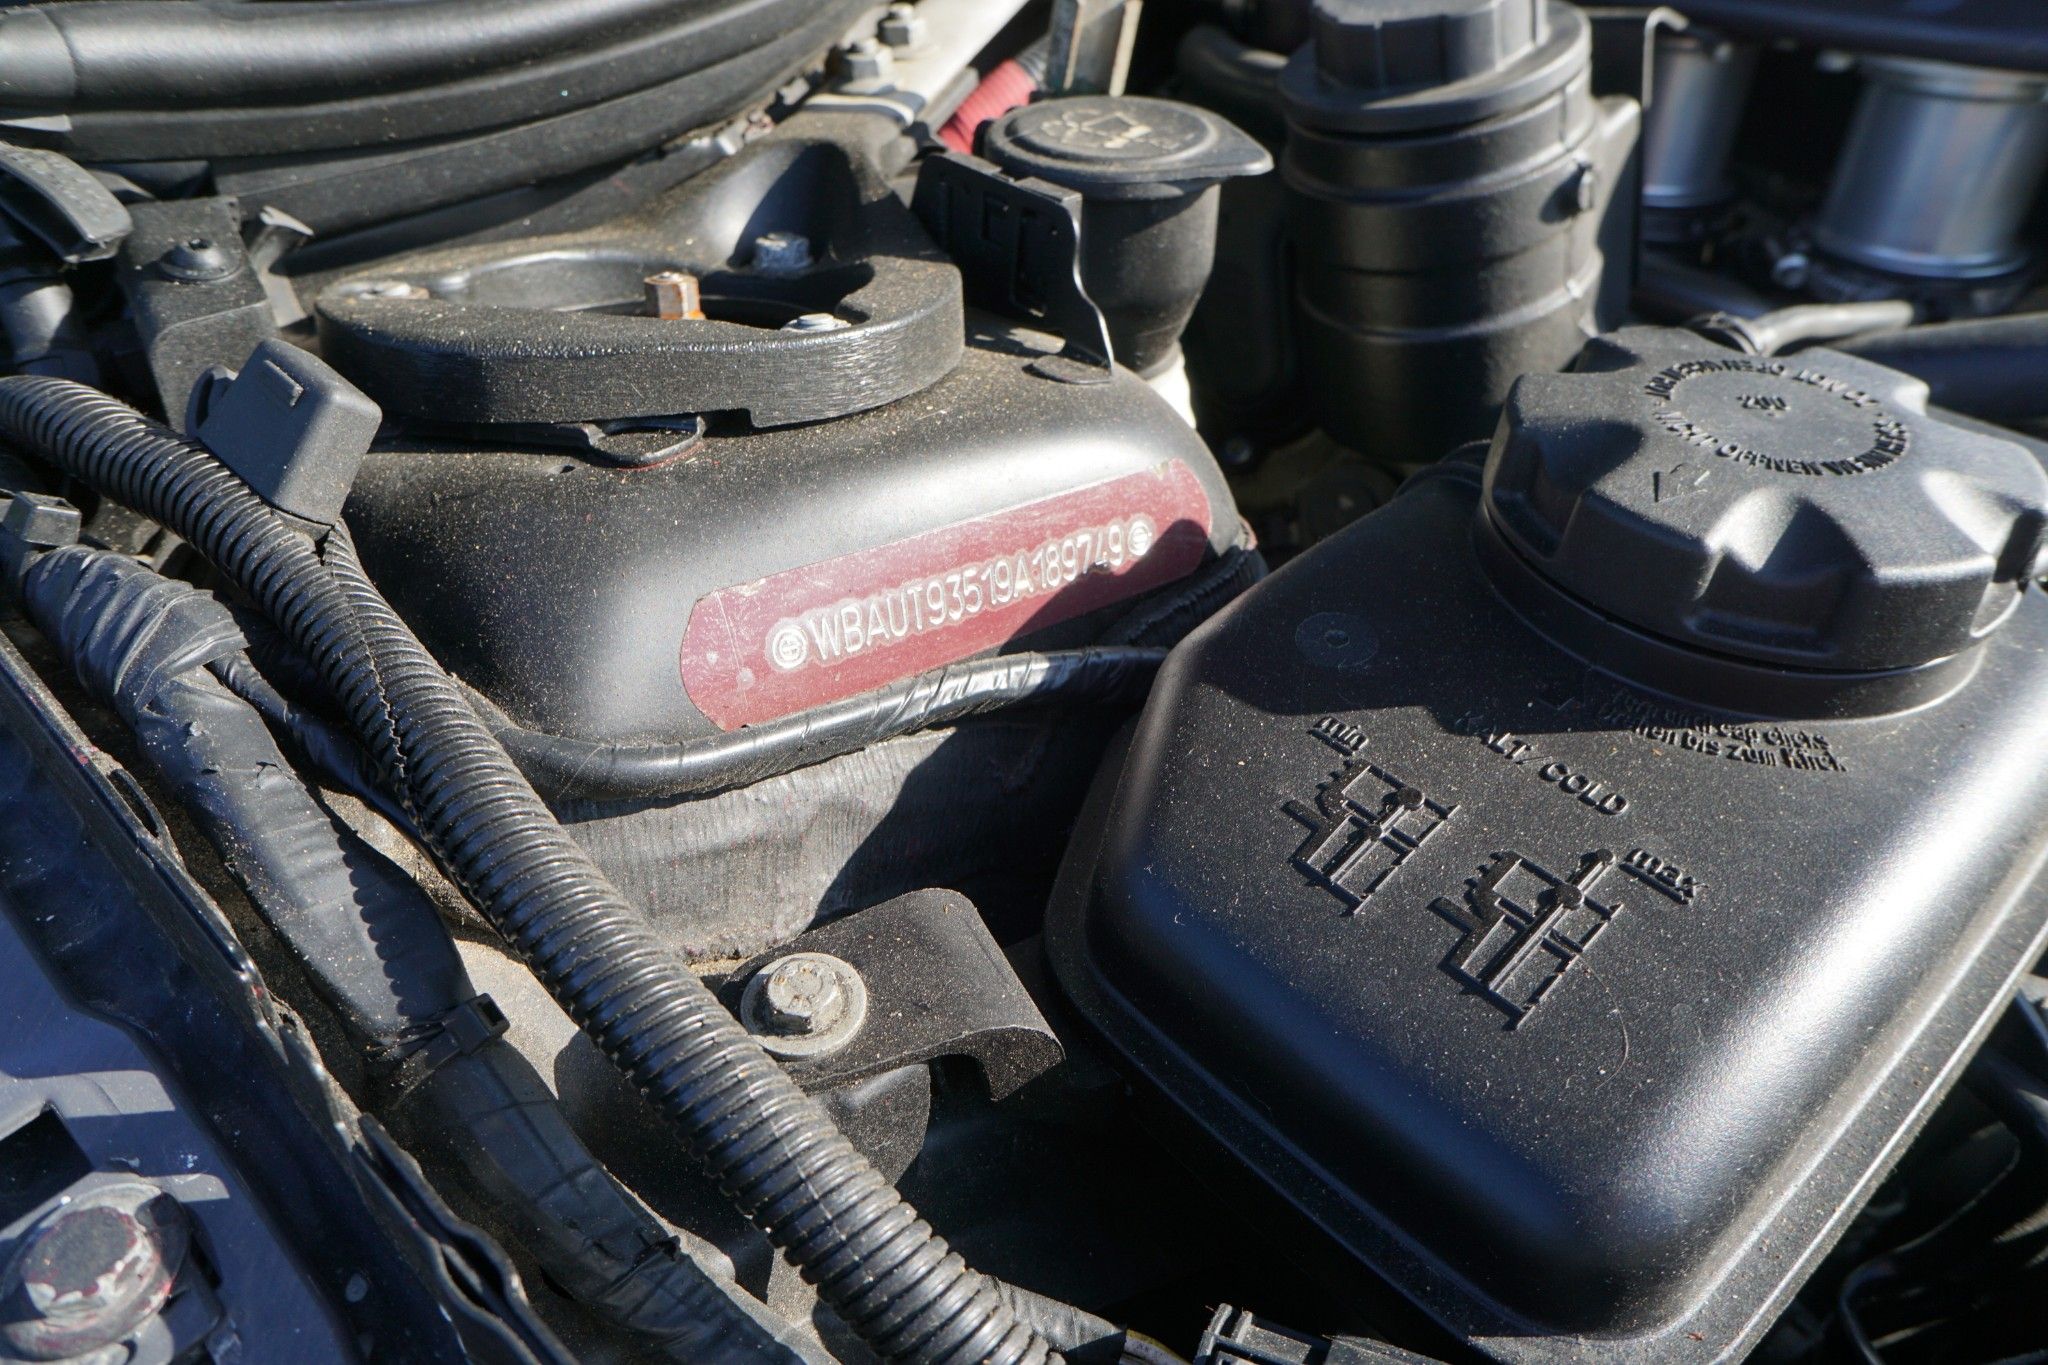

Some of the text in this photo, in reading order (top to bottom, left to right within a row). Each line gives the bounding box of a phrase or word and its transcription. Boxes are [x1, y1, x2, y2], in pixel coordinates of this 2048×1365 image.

[808, 524, 1124, 661] WBAUT93519A189749
[1311, 715, 1370, 752] min
[1622, 847, 1709, 899] max
